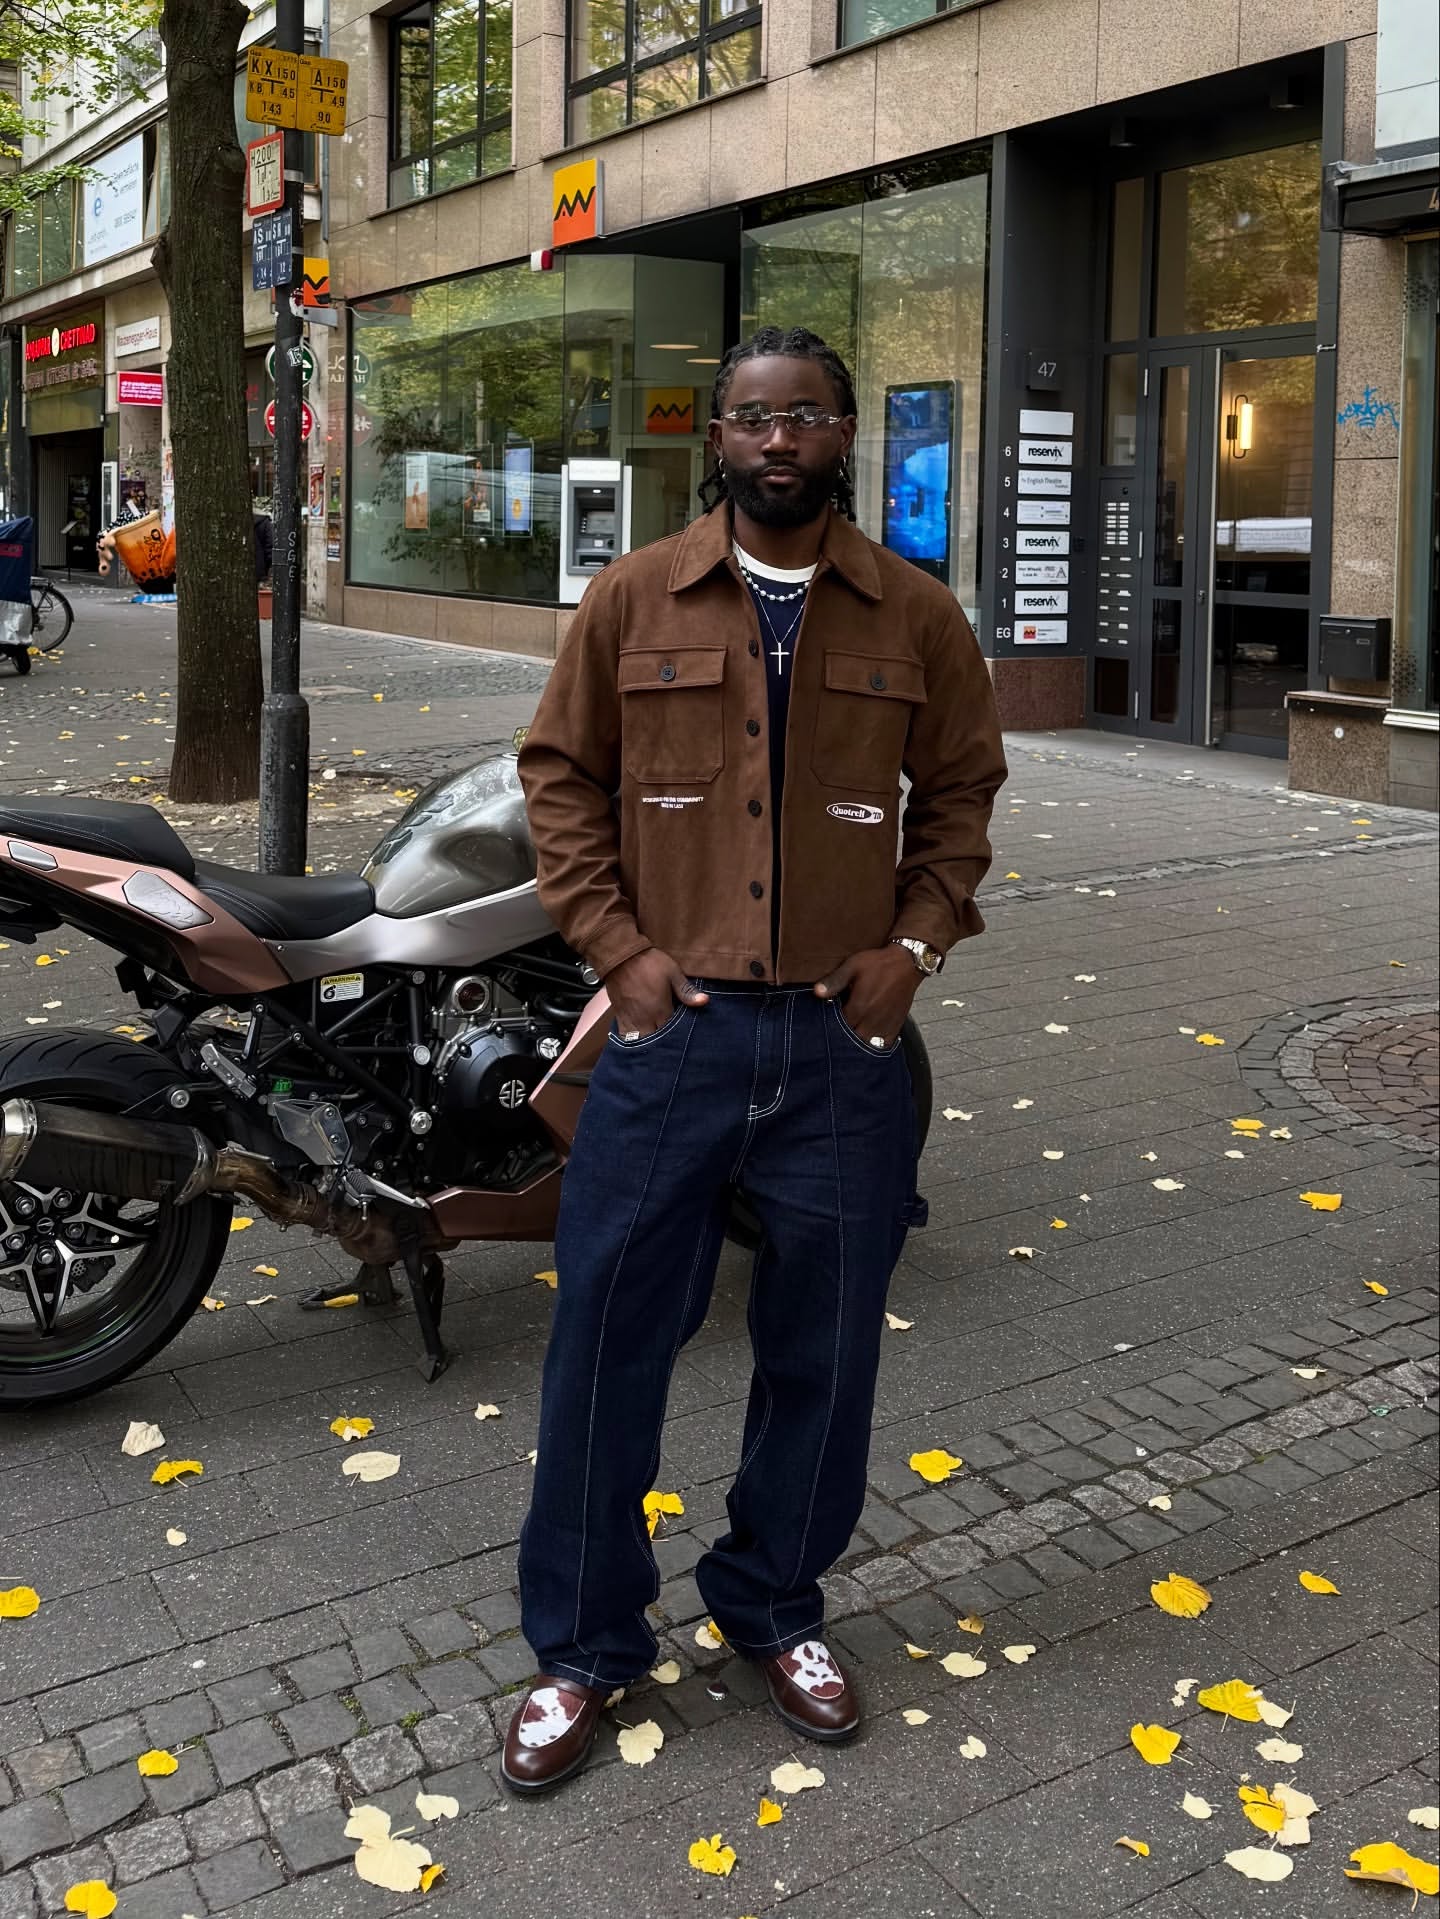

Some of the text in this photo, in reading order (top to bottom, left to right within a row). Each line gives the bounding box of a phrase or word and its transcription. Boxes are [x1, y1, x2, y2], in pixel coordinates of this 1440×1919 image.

[1038, 362, 1057, 377] 47
[1004, 446, 1011, 457] 6
[1028, 446, 1063, 460] reservix
[1004, 477, 1011, 487] 5
[1003, 507, 1010, 518] 4
[1002, 537, 1009, 548] 3
[1025, 536, 1060, 550] reservix
[1001, 568, 1008, 578] 2
[1002, 598, 1007, 608] 1
[1024, 595, 1059, 609] reservix
[996, 628, 1011, 638] EG
